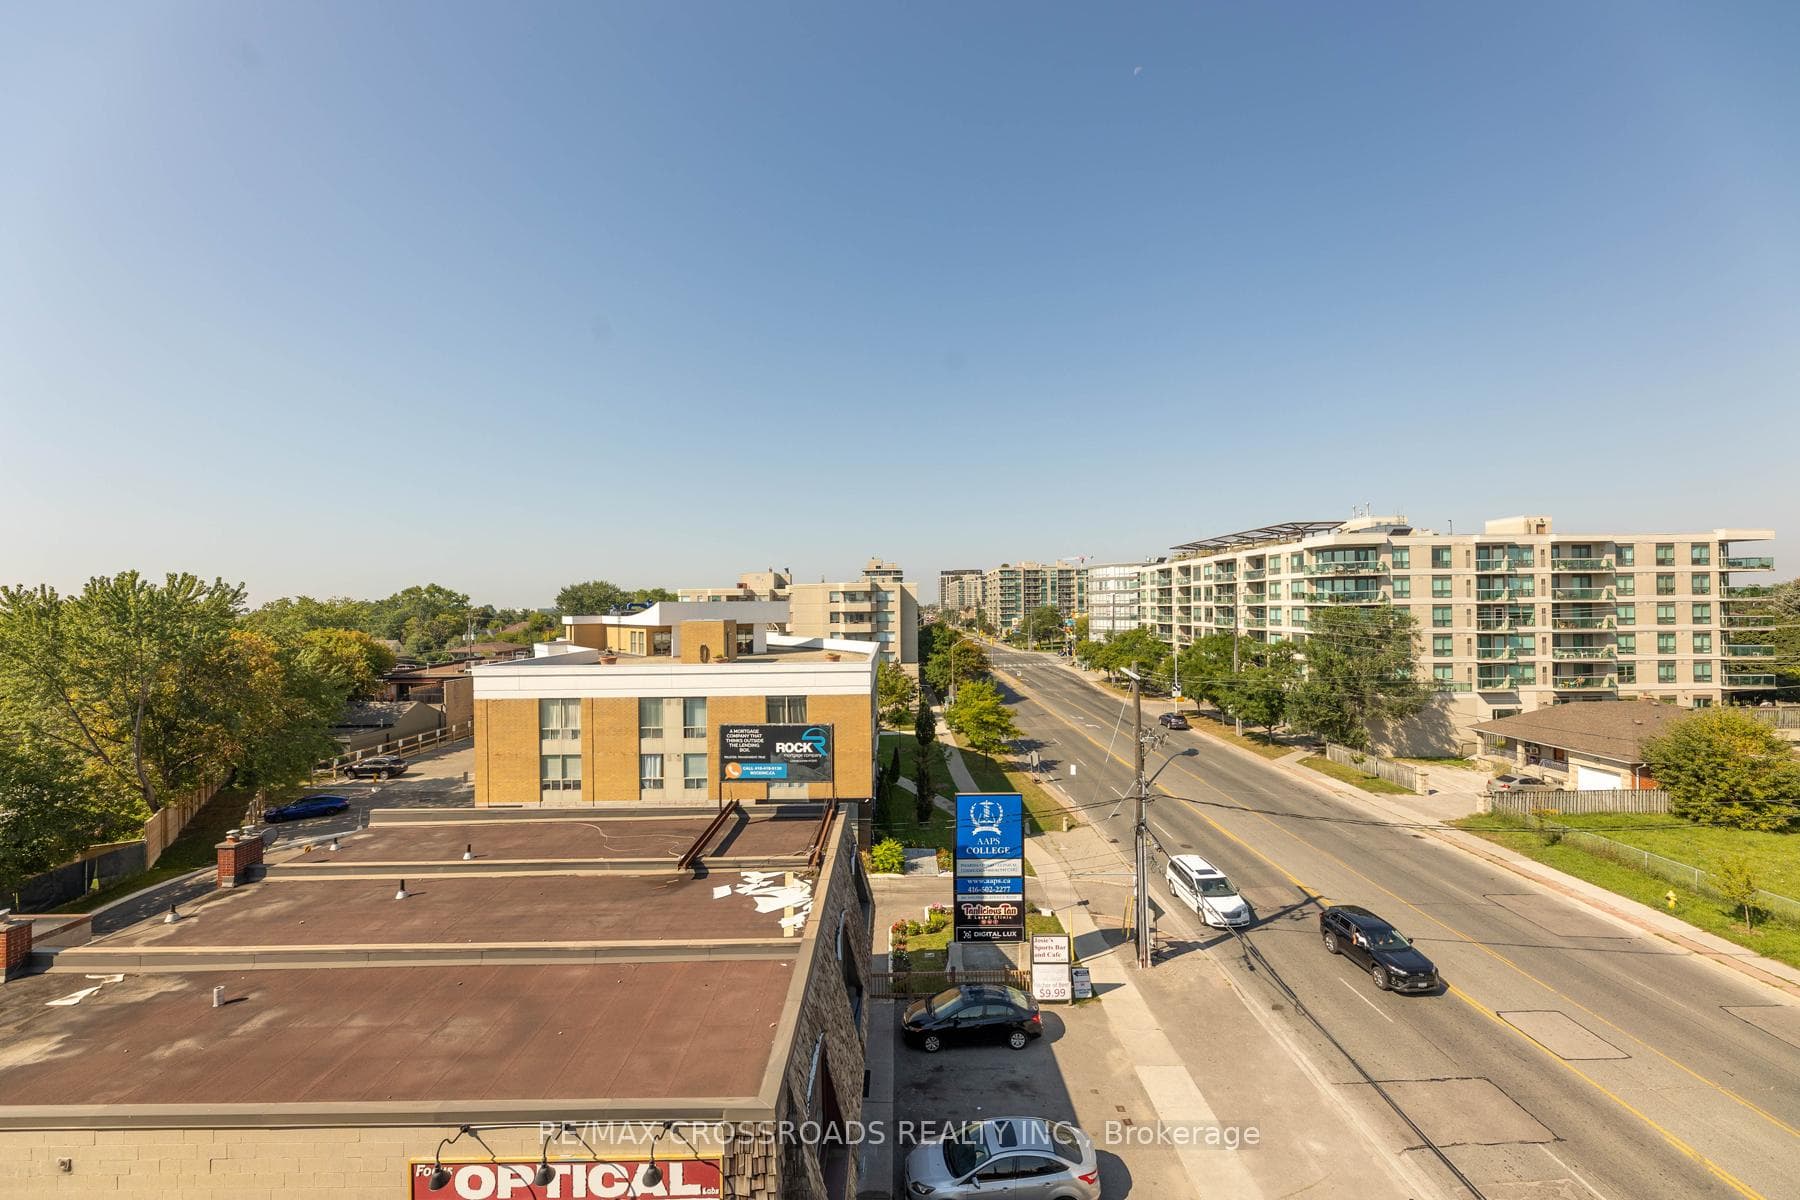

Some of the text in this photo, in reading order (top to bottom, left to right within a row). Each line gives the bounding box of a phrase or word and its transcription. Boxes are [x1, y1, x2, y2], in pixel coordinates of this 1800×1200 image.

[776, 742, 813, 752] ROCK
[966, 846, 1010, 854] COLLEGE
[962, 904, 1017, 915] Tanlicious Tan
[1039, 988, 1066, 998] $9.99
[454, 1162, 701, 1200] OPTICAL
